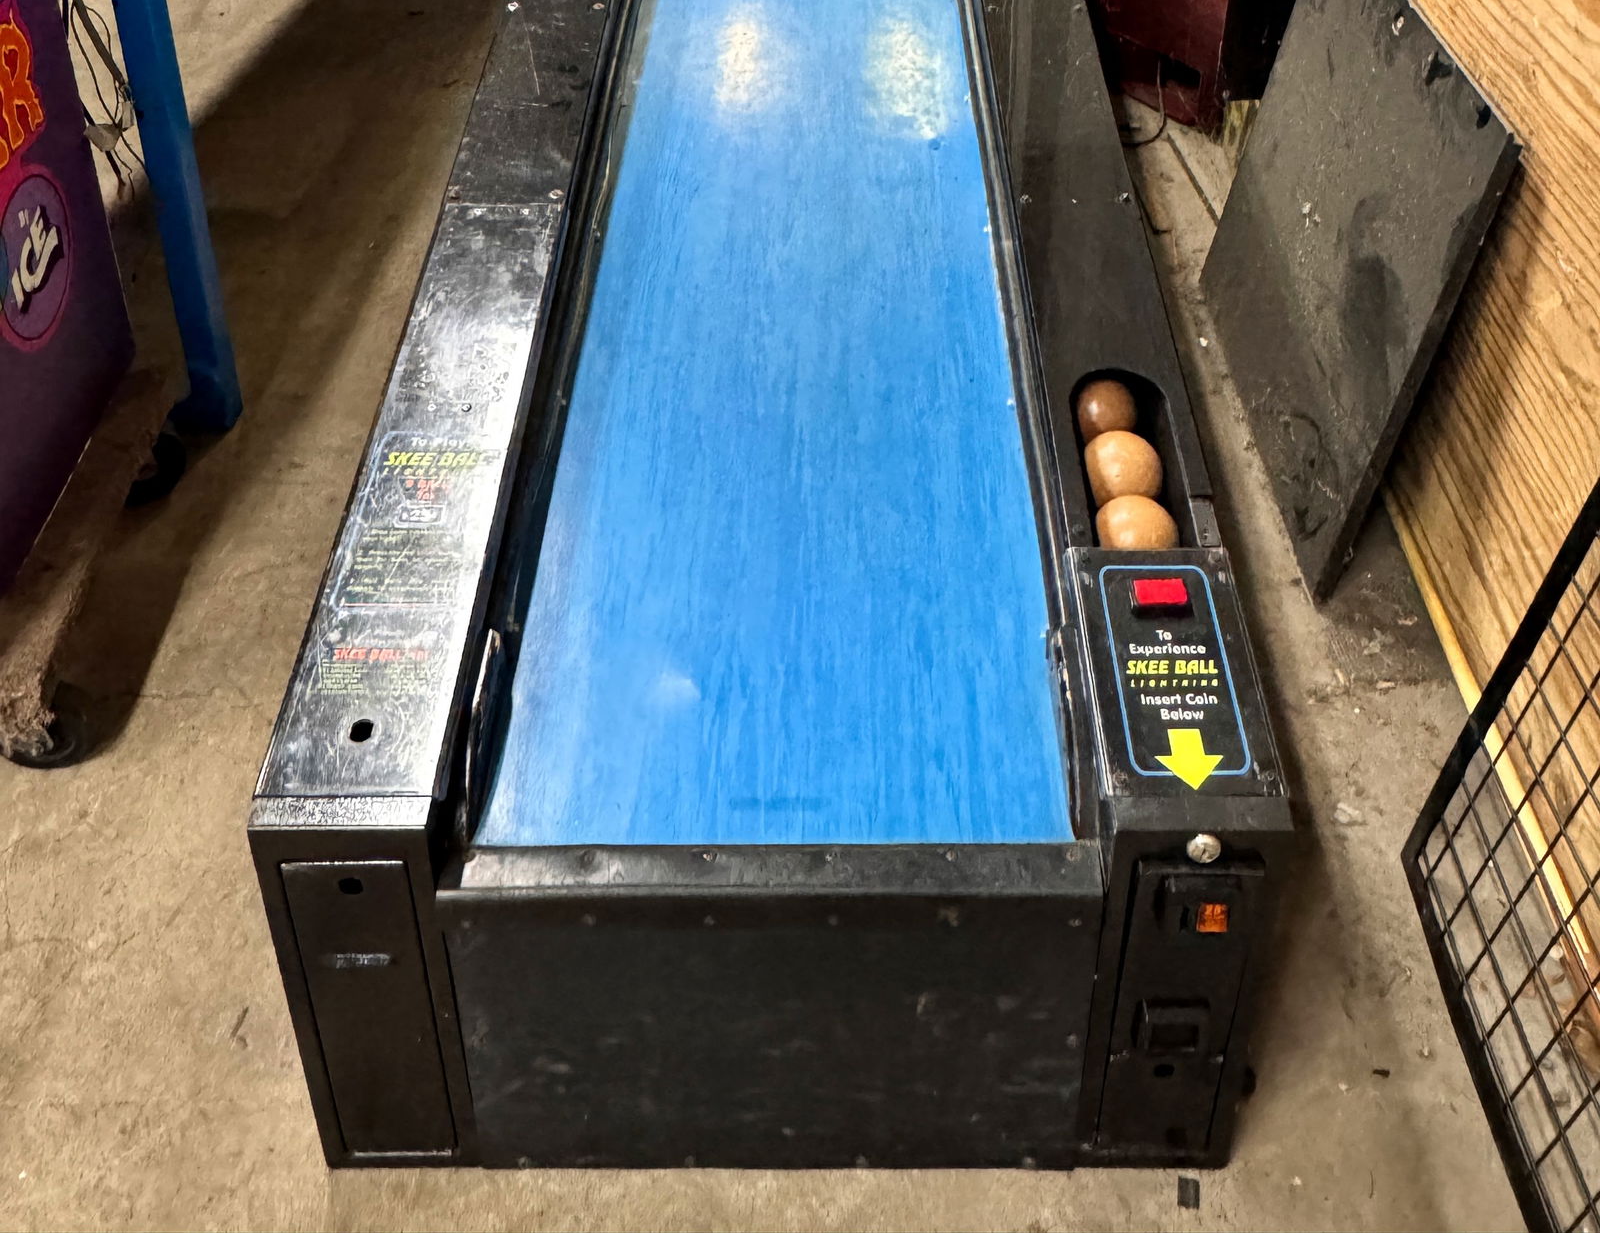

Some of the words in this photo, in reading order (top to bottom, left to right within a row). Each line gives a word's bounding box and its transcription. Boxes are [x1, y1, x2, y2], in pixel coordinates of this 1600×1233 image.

[383, 451, 437, 466] SKEE
[1155, 629, 1172, 641] To
[1129, 643, 1206, 657] Experience
[1126, 659, 1169, 675] SKEE
[1174, 659, 1218, 675] BALL
[1130, 678, 1218, 687] LIGHTNING
[1140, 693, 1181, 705] Insert
[1185, 692, 1218, 705] Coin
[1160, 707, 1204, 720] Below
